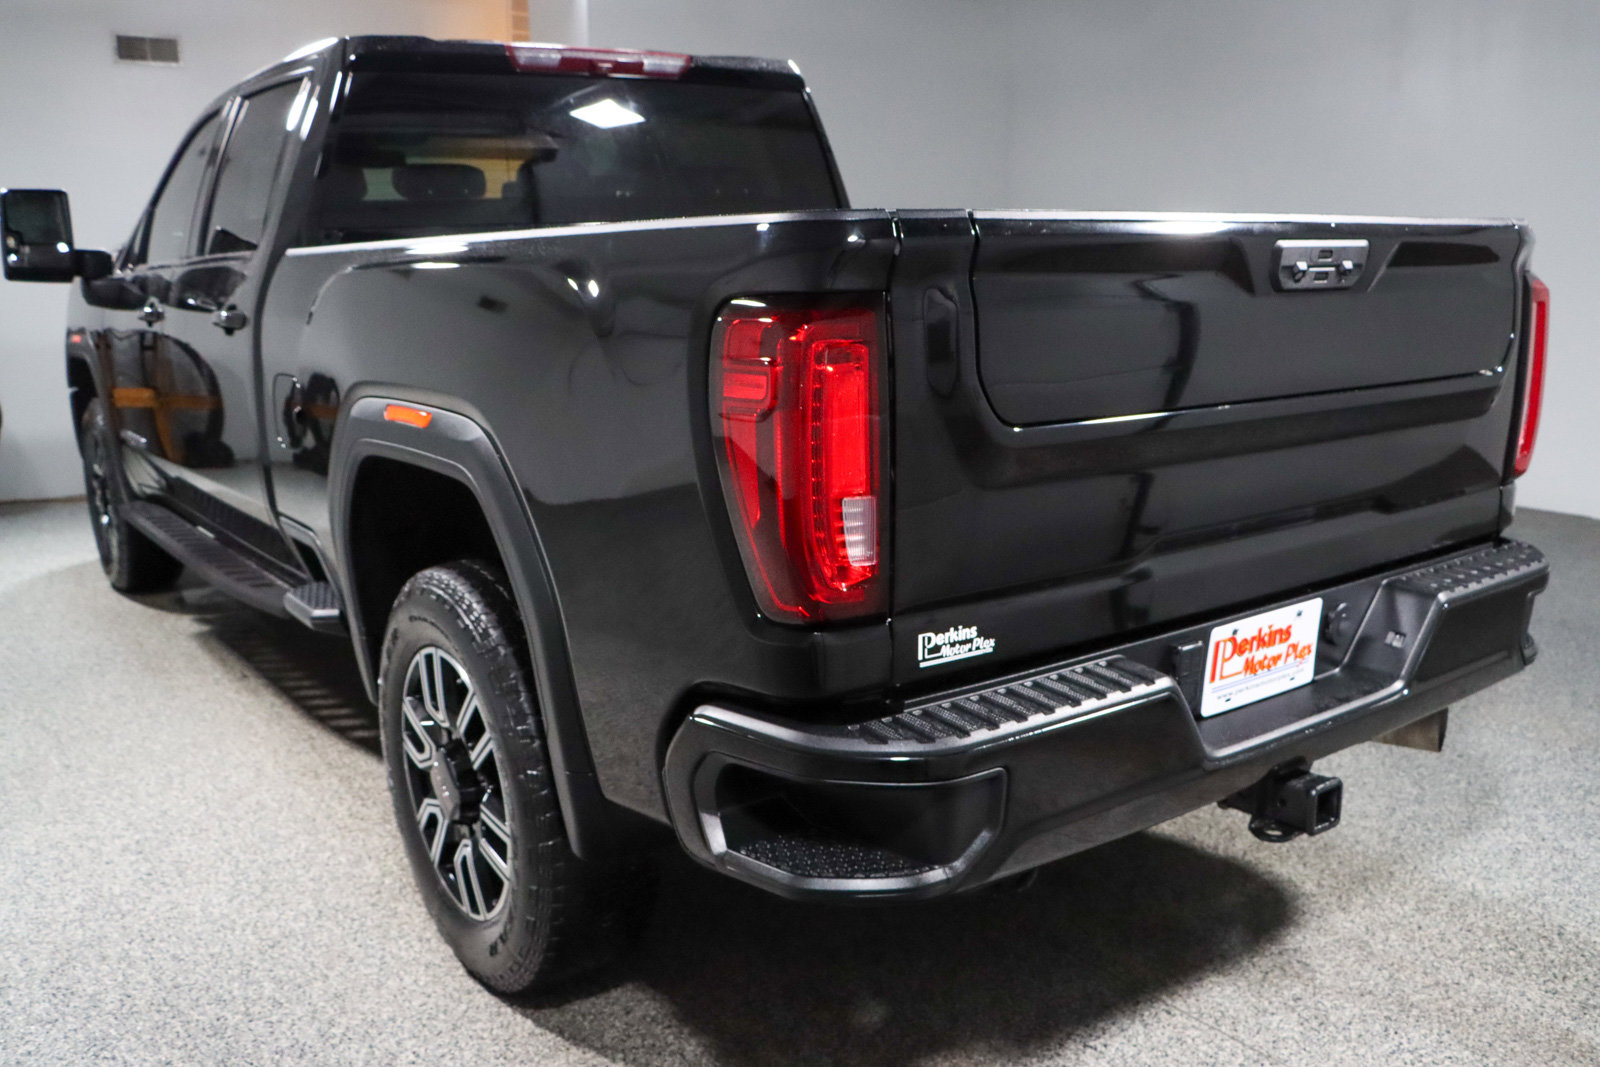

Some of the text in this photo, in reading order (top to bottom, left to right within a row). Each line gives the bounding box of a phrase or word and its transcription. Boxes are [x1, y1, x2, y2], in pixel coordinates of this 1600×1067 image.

[918, 625, 978, 661] Perkins
[940, 636, 996, 658] Motor Plex
[1210, 624, 1292, 683] Perkins
[1243, 653, 1282, 678] Motor
